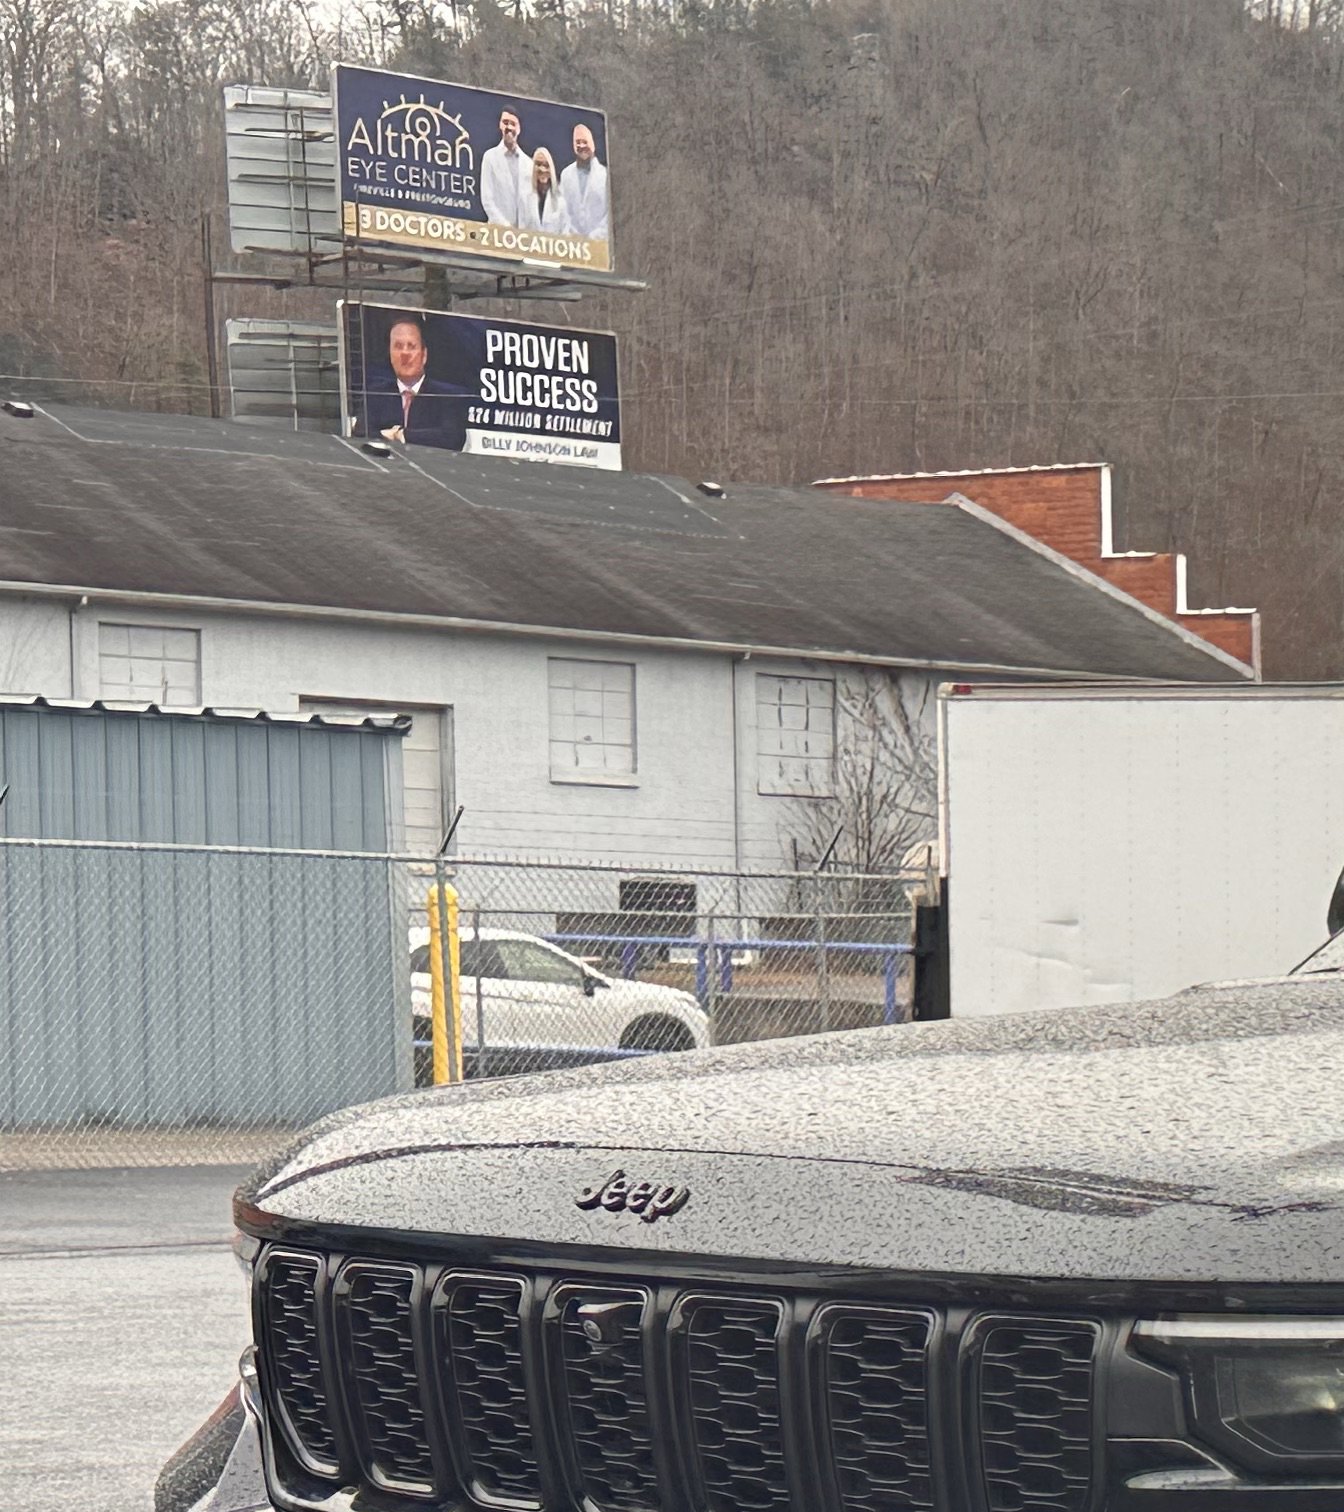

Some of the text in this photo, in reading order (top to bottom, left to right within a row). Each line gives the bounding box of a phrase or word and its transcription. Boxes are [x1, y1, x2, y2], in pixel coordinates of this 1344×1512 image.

[347, 117, 474, 170] Altman
[348, 156, 476, 195] EYE CENTER
[360, 209, 371, 230] 3
[376, 211, 466, 242] DOCTORS
[494, 230, 592, 261] LOCATIONS
[486, 329, 589, 374] PROVEN
[480, 368, 598, 414] SUCCESS
[575, 1169, 691, 1224] Jeep
